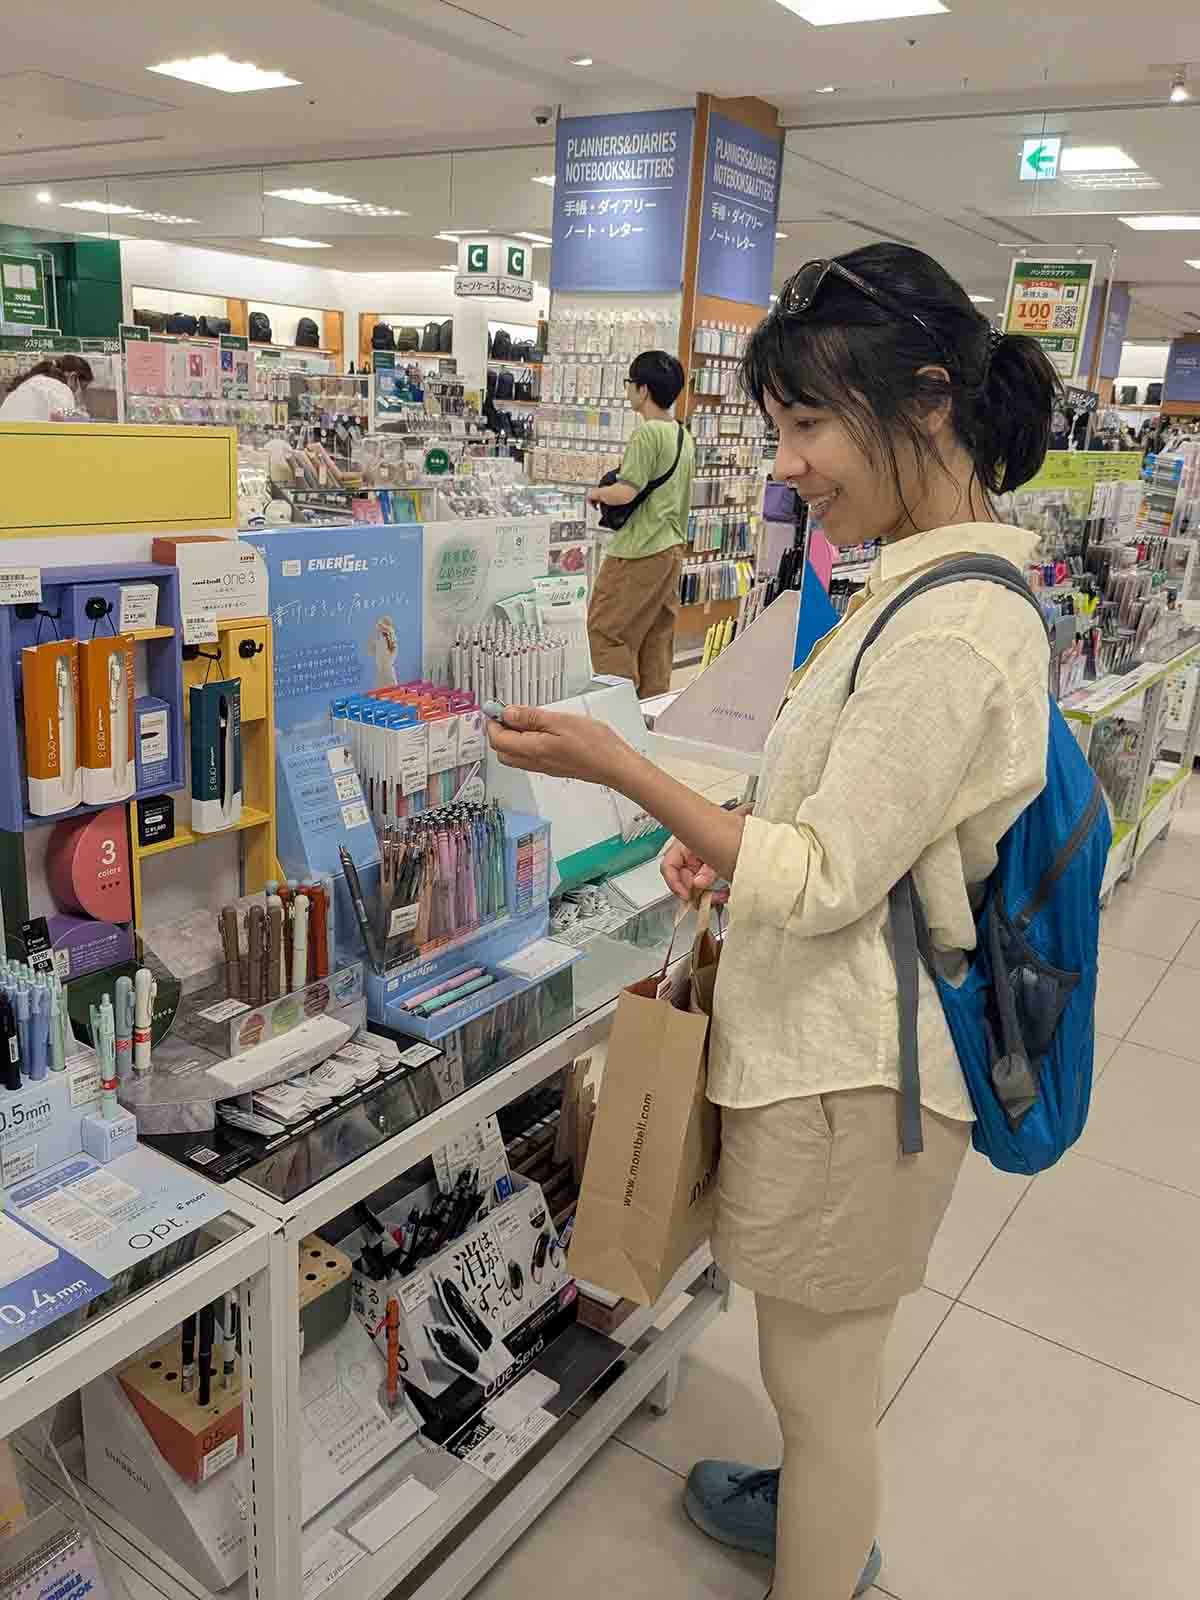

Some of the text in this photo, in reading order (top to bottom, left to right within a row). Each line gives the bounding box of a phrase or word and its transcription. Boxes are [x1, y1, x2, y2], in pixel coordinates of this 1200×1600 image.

[567, 131, 677, 158] PLANNERS&DIARIES
[565, 157, 674, 183] NOTEBOOKS&LETTERS
[715, 136, 776, 180] PLANNERS&DIARIES
[713, 161, 775, 203] NOTEBOOKS&LETTERS
[563, 199, 657, 216] 手帳・ダイアリー
[563, 223, 644, 240] ノート・レター
[471, 248, 484, 267] C
[511, 251, 522, 271] C
[1017, 303, 1051, 318] 100
[222, 572, 246, 586] one
[248, 569, 256, 584] 3
[102, 839, 116, 865] 3
[98, 866, 121, 879] colors
[623, 1092, 653, 1208] www.montbell.com
[128, 1217, 191, 1250] Opt.
[0, 1279, 88, 1325] 0.4mm
